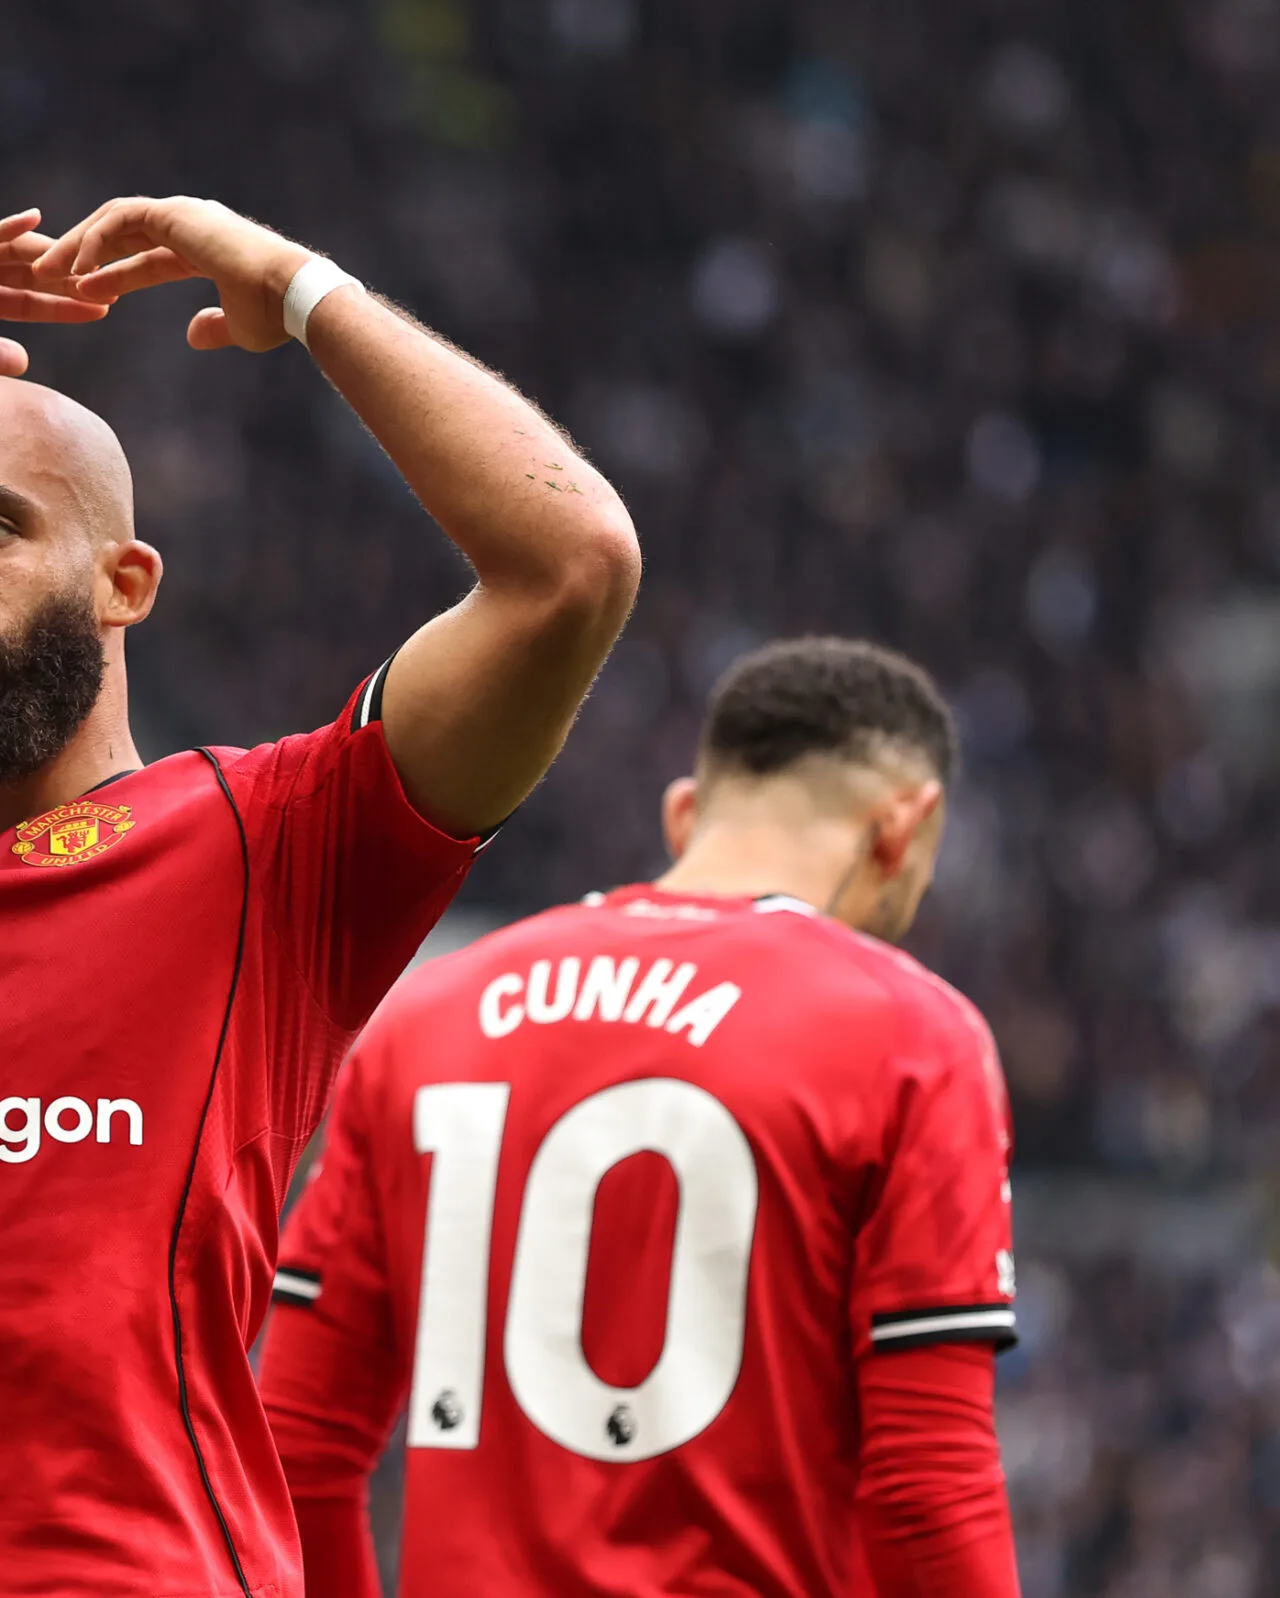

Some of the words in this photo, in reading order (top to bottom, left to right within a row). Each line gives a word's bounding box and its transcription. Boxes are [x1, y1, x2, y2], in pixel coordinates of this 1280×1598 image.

[25, 806, 123, 837] MANCHESTER
[40, 844, 109, 867] UNITED
[479, 955, 742, 1048] CUNHA
[406, 1076, 759, 1464] 10
